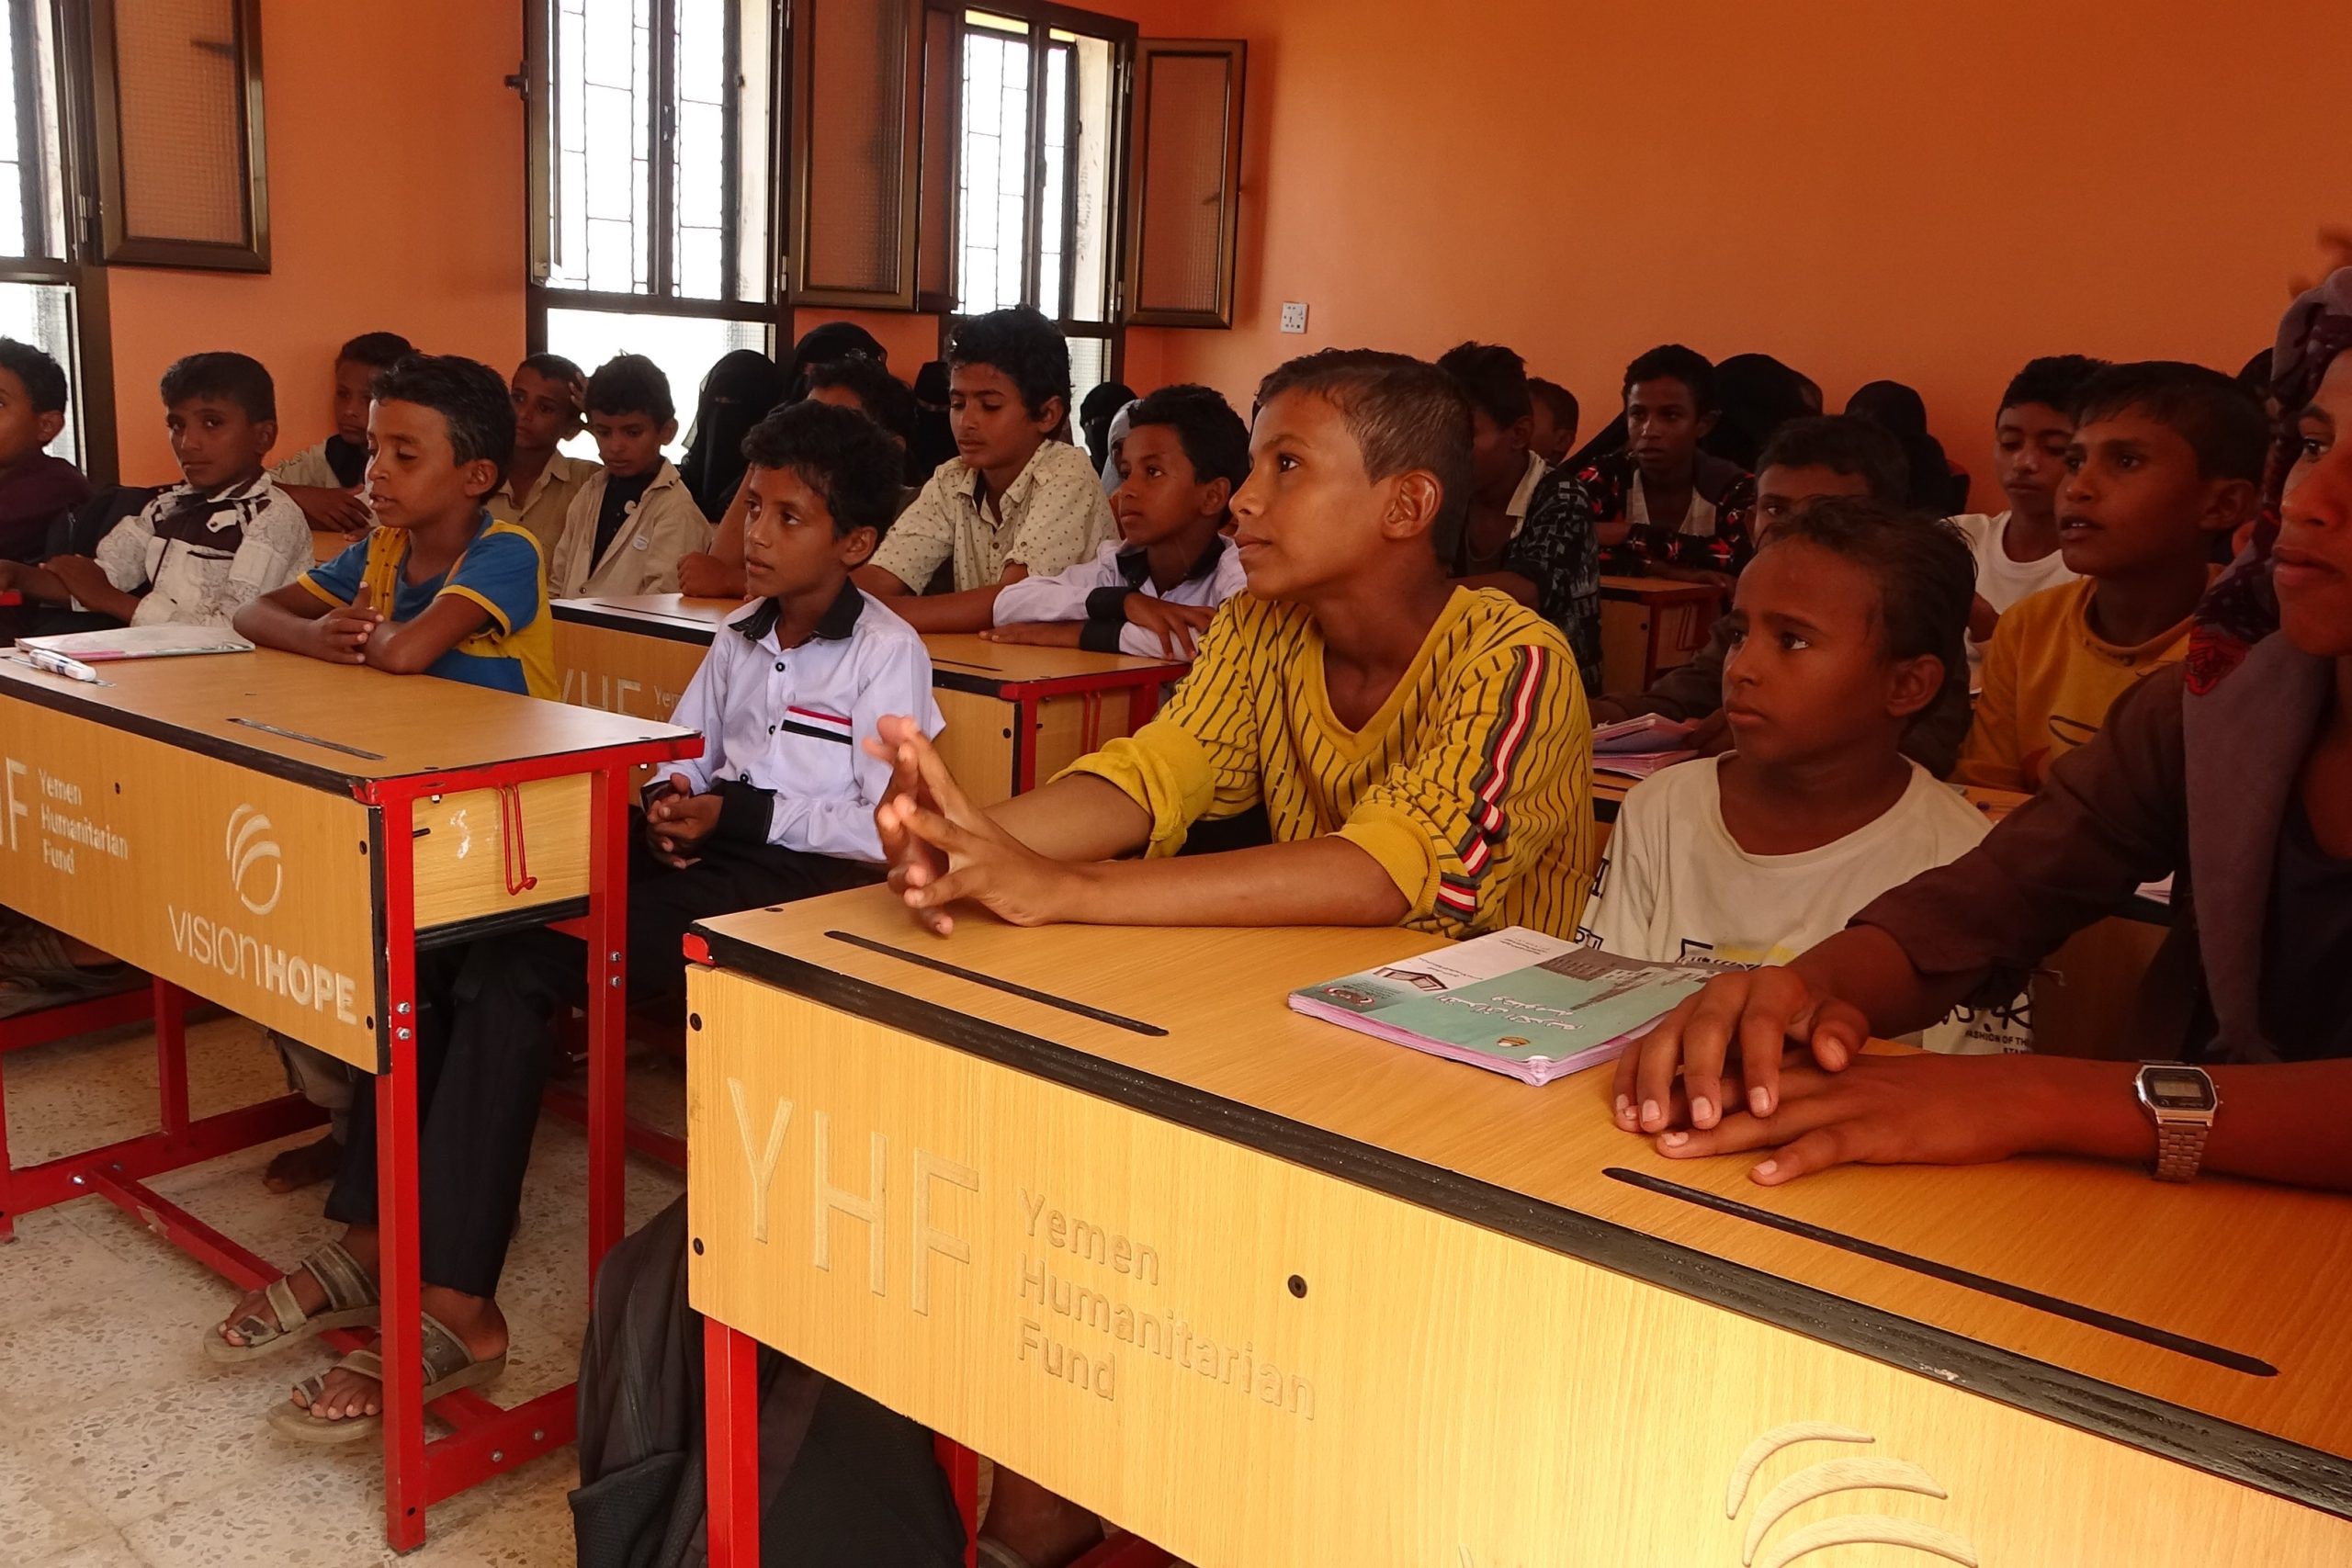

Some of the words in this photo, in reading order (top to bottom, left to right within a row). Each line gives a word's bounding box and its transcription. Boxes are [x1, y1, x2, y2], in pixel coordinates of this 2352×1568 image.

[38, 768, 83, 806] Yemen
[41, 804, 129, 860] Humanitarian
[43, 838, 75, 874] Fund
[2002, 1034, 2014, 1044] OF
[728, 1077, 980, 1316] YHF
[1020, 1187, 1160, 1286] Yemen
[1017, 1315, 1116, 1402] Fund
[1018, 1253, 1316, 1420] Humanitarian
